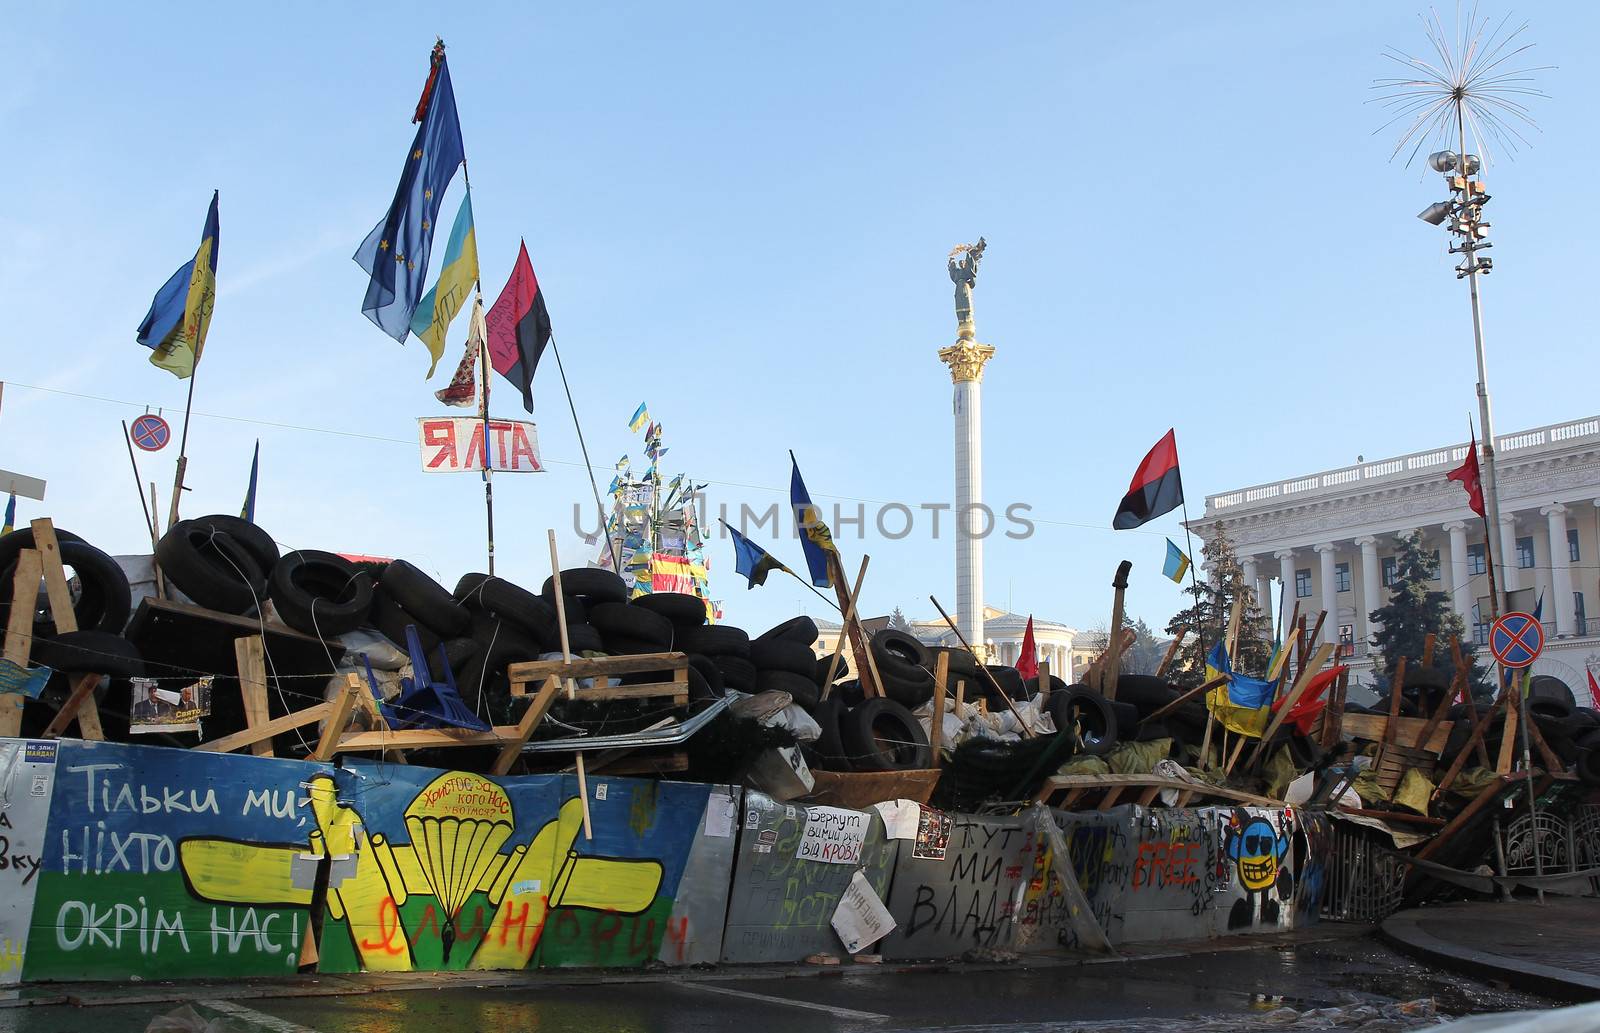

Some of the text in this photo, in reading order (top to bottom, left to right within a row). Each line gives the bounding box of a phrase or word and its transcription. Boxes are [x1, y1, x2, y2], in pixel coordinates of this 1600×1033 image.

[423, 421, 541, 470] ЯЛТА
[808, 807, 860, 831] Беркут
[955, 821, 1023, 850] ТУТ
[822, 842, 863, 863] КРОВІ!
[950, 852, 1003, 887] МИ
[1131, 841, 1201, 894] FREE
[55, 896, 300, 967] ОКРІМ НАС!
[905, 884, 1015, 947] ВЛАДА
